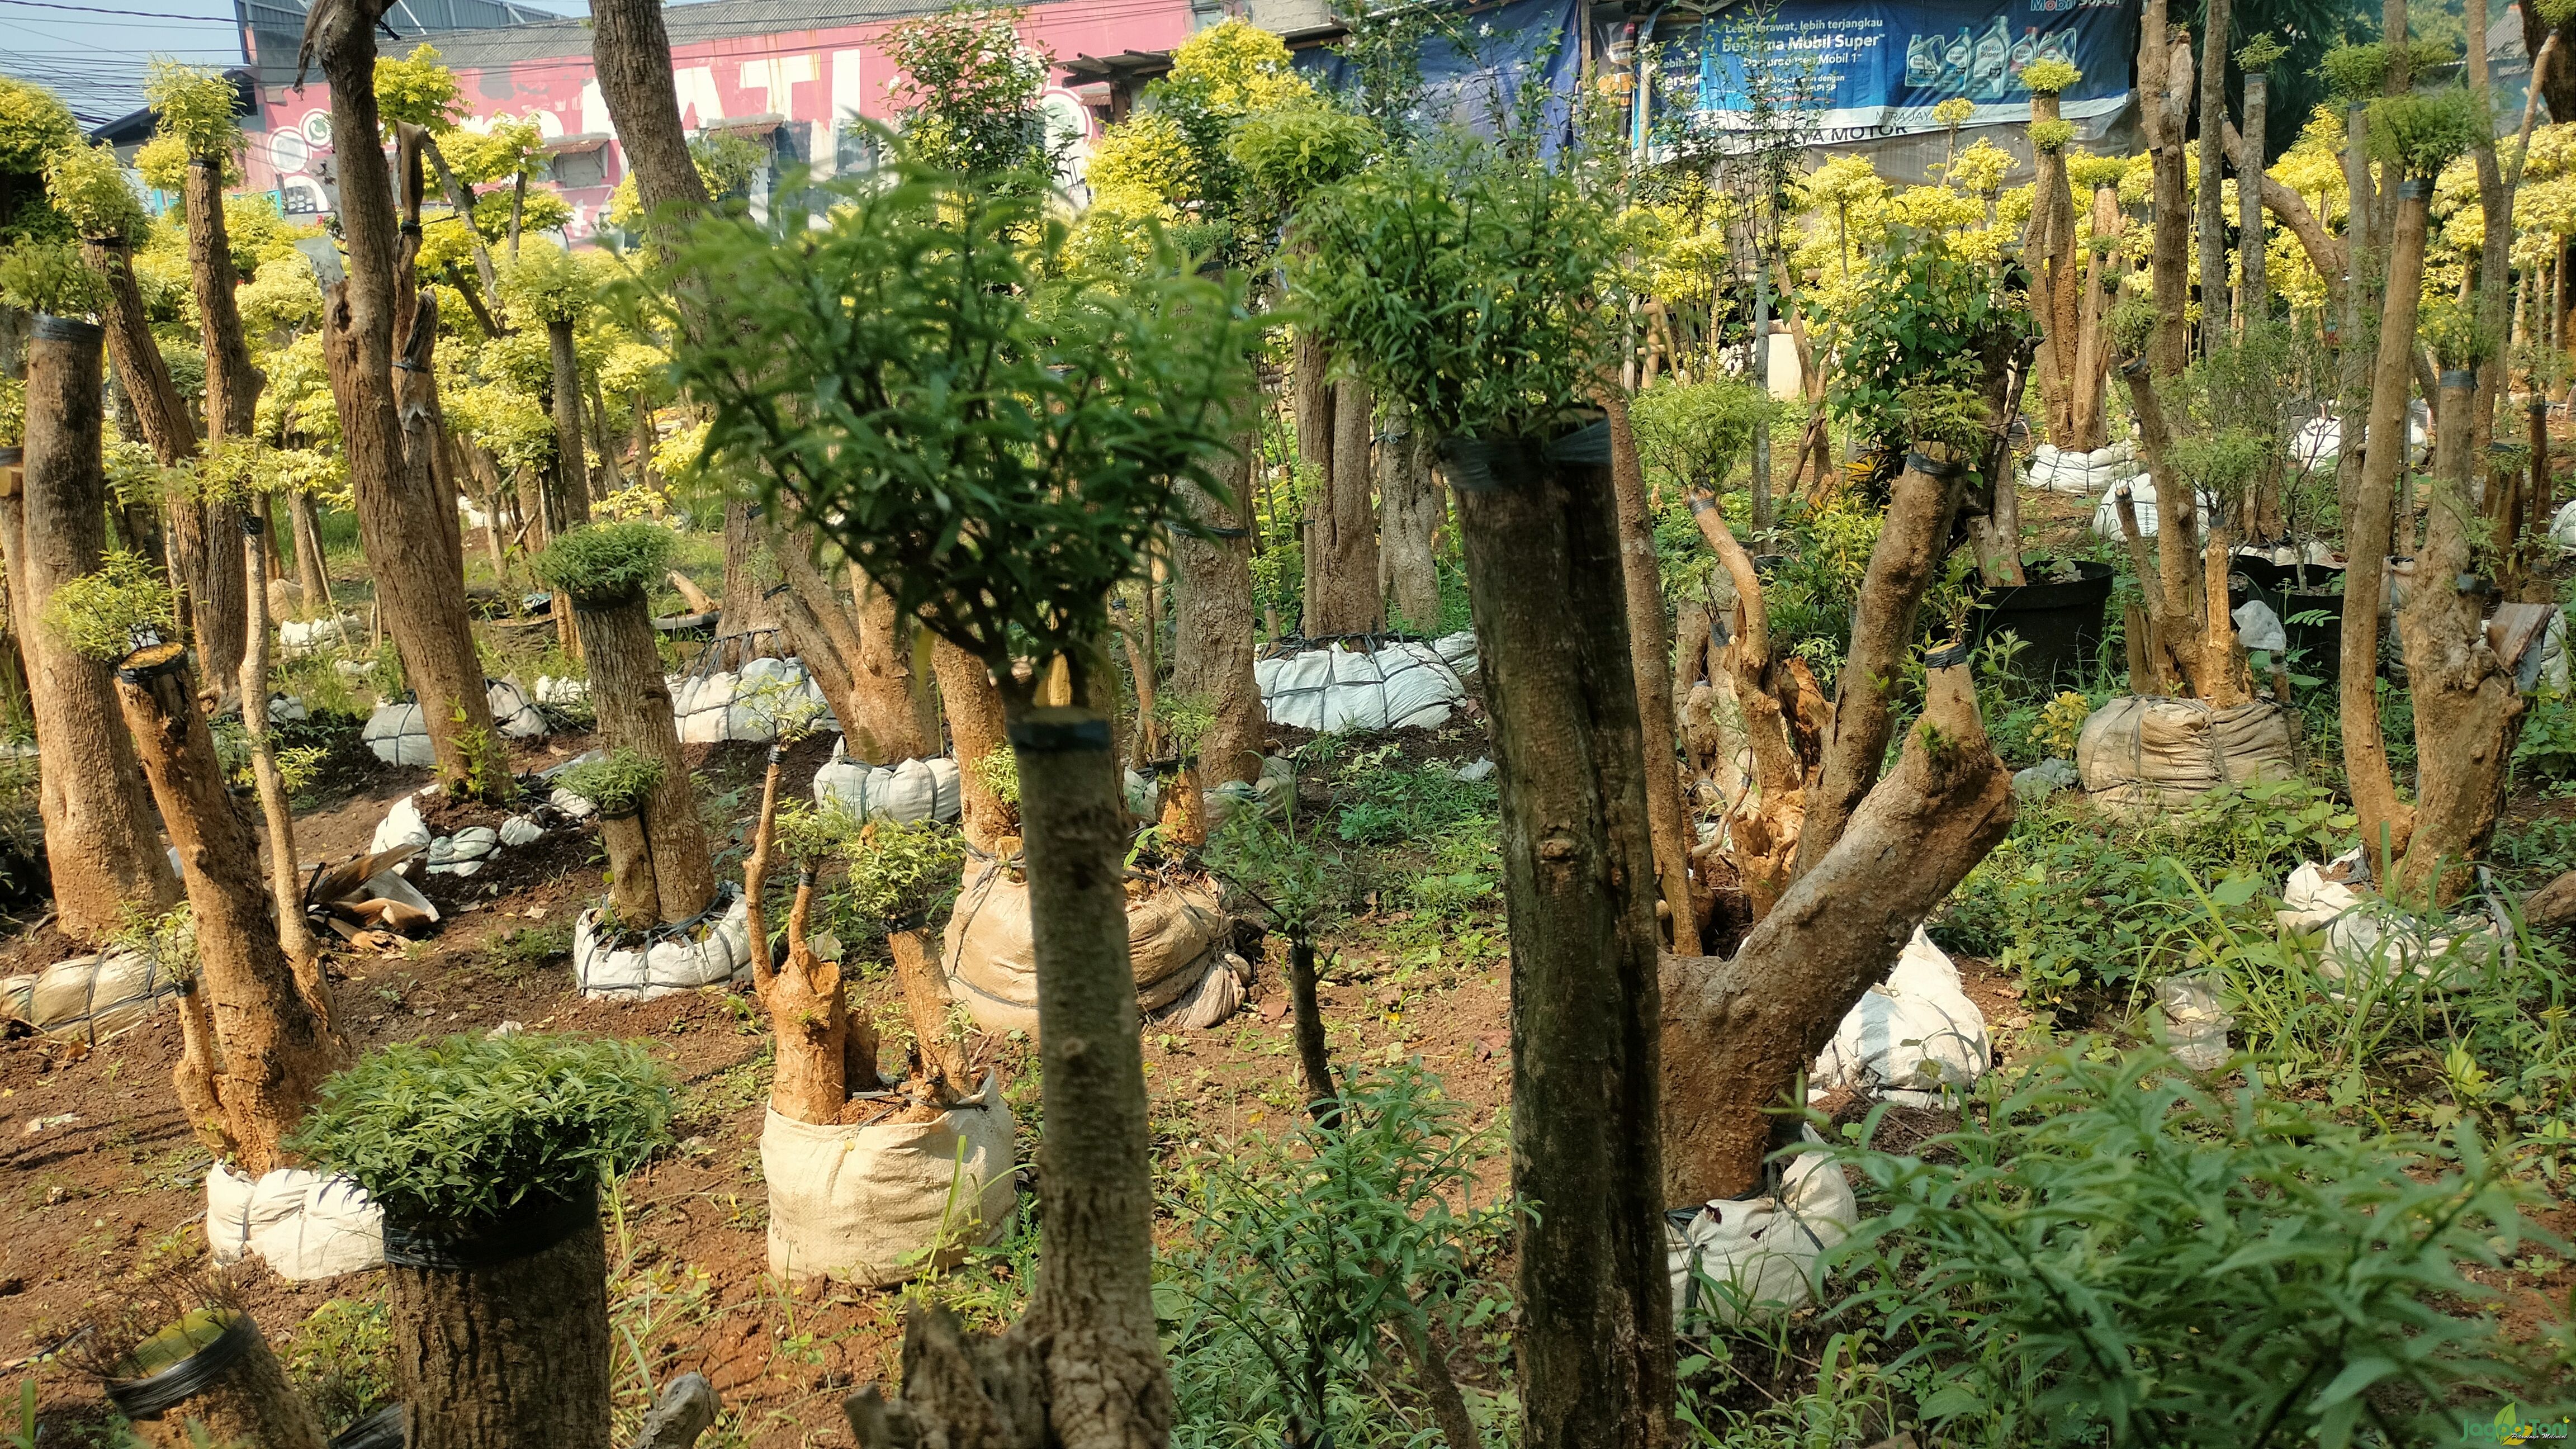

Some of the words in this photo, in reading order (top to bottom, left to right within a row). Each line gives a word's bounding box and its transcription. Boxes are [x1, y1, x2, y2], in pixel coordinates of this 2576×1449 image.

[2030, 0, 2076, 11] Mobil
[1800, 20, 1825, 30] lebih
[1827, 17, 1883, 31] terjangkau
[1789, 34, 1831, 49] Mobil
[1663, 56, 1685, 69] ebih
[1819, 53, 1848, 64] Mobil
[1876, 111, 1905, 121] MITRA
[1831, 124, 1908, 141] MOTOR
